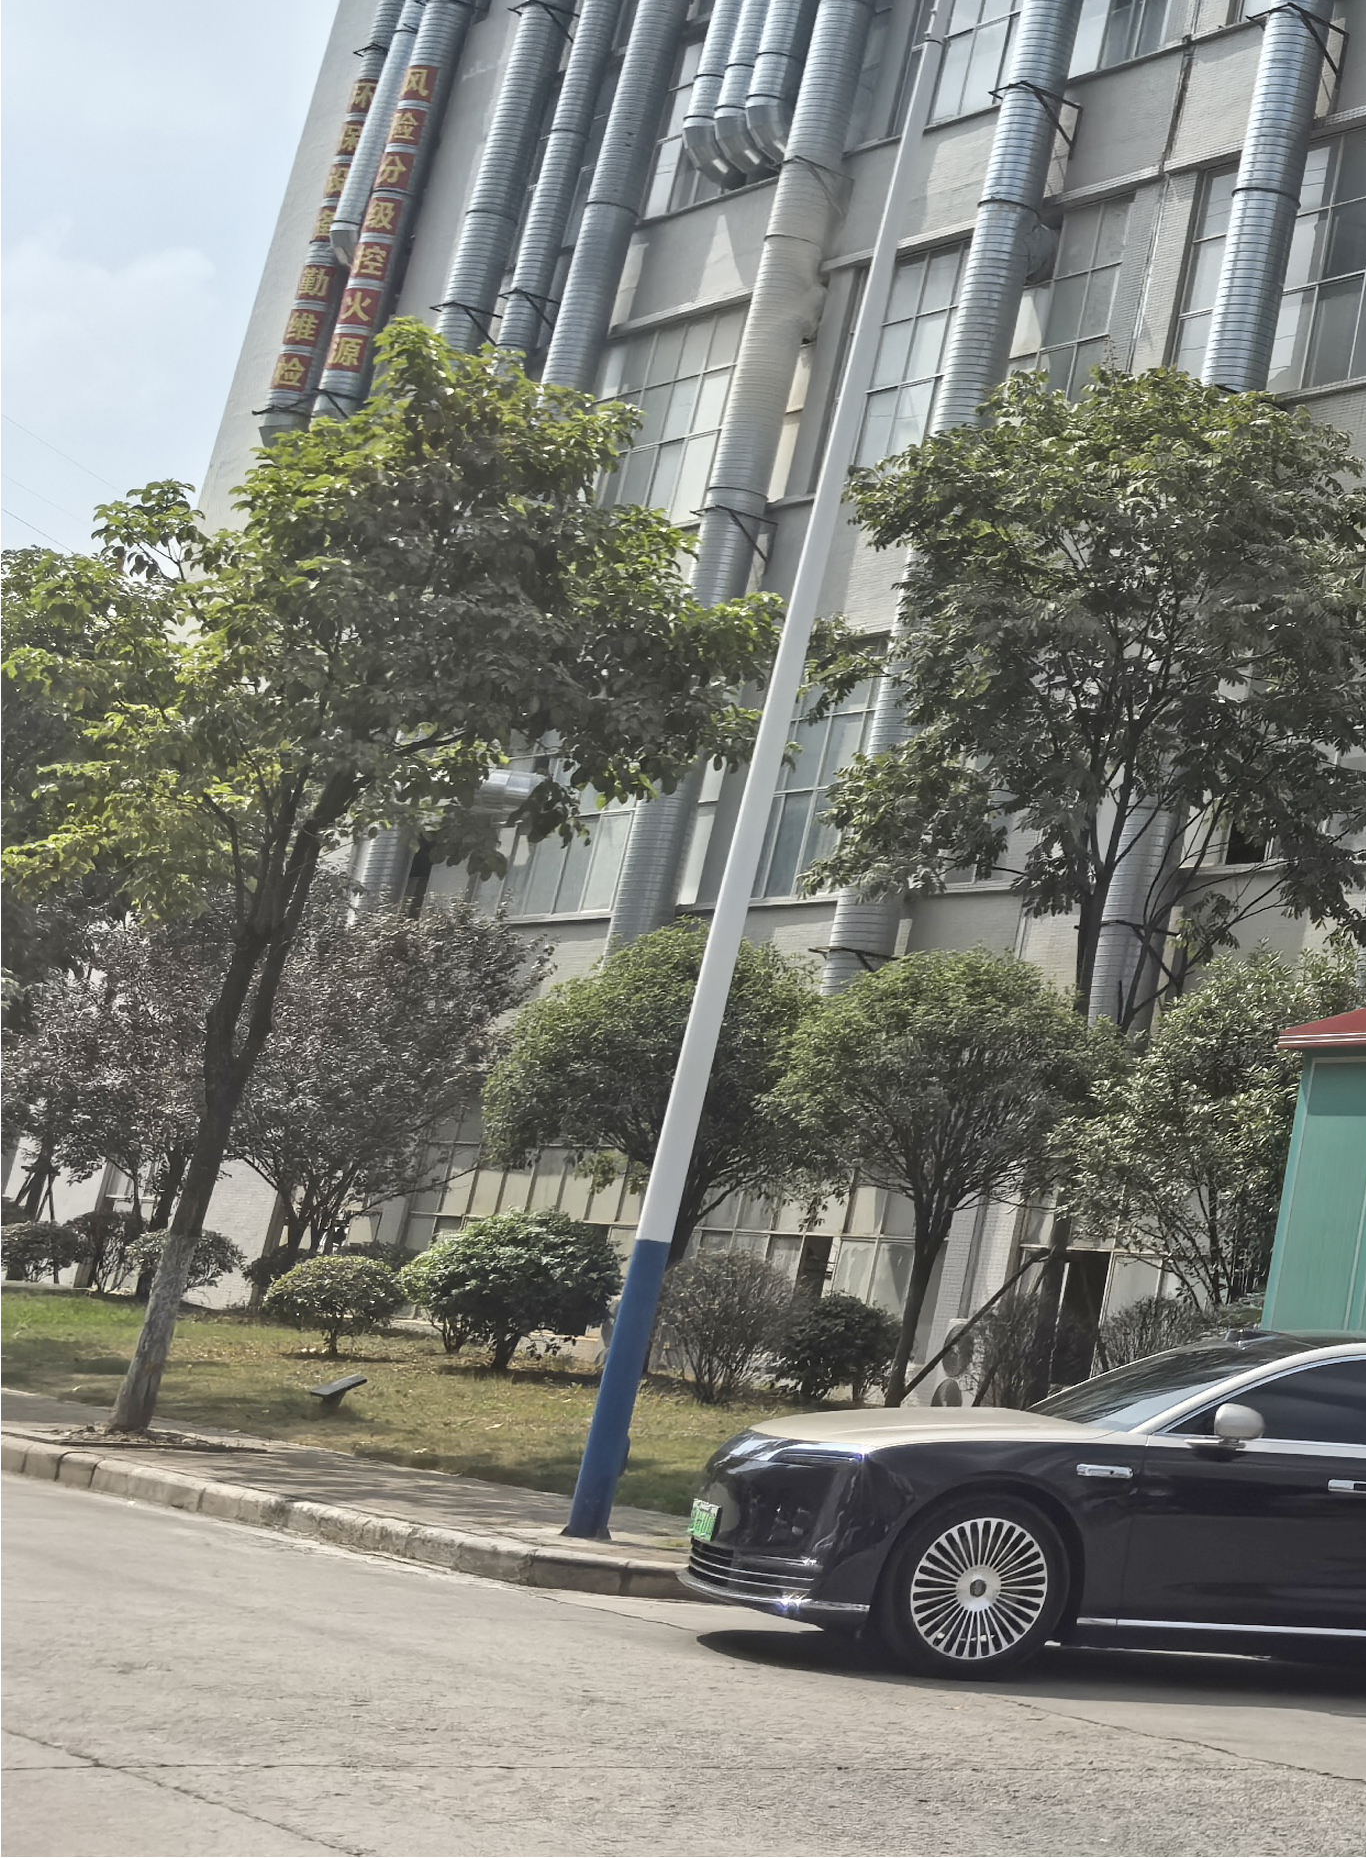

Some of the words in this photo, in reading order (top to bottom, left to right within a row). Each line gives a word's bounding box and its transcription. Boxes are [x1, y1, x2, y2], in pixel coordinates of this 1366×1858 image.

[329, 68, 430, 367] 风险分级控火源
